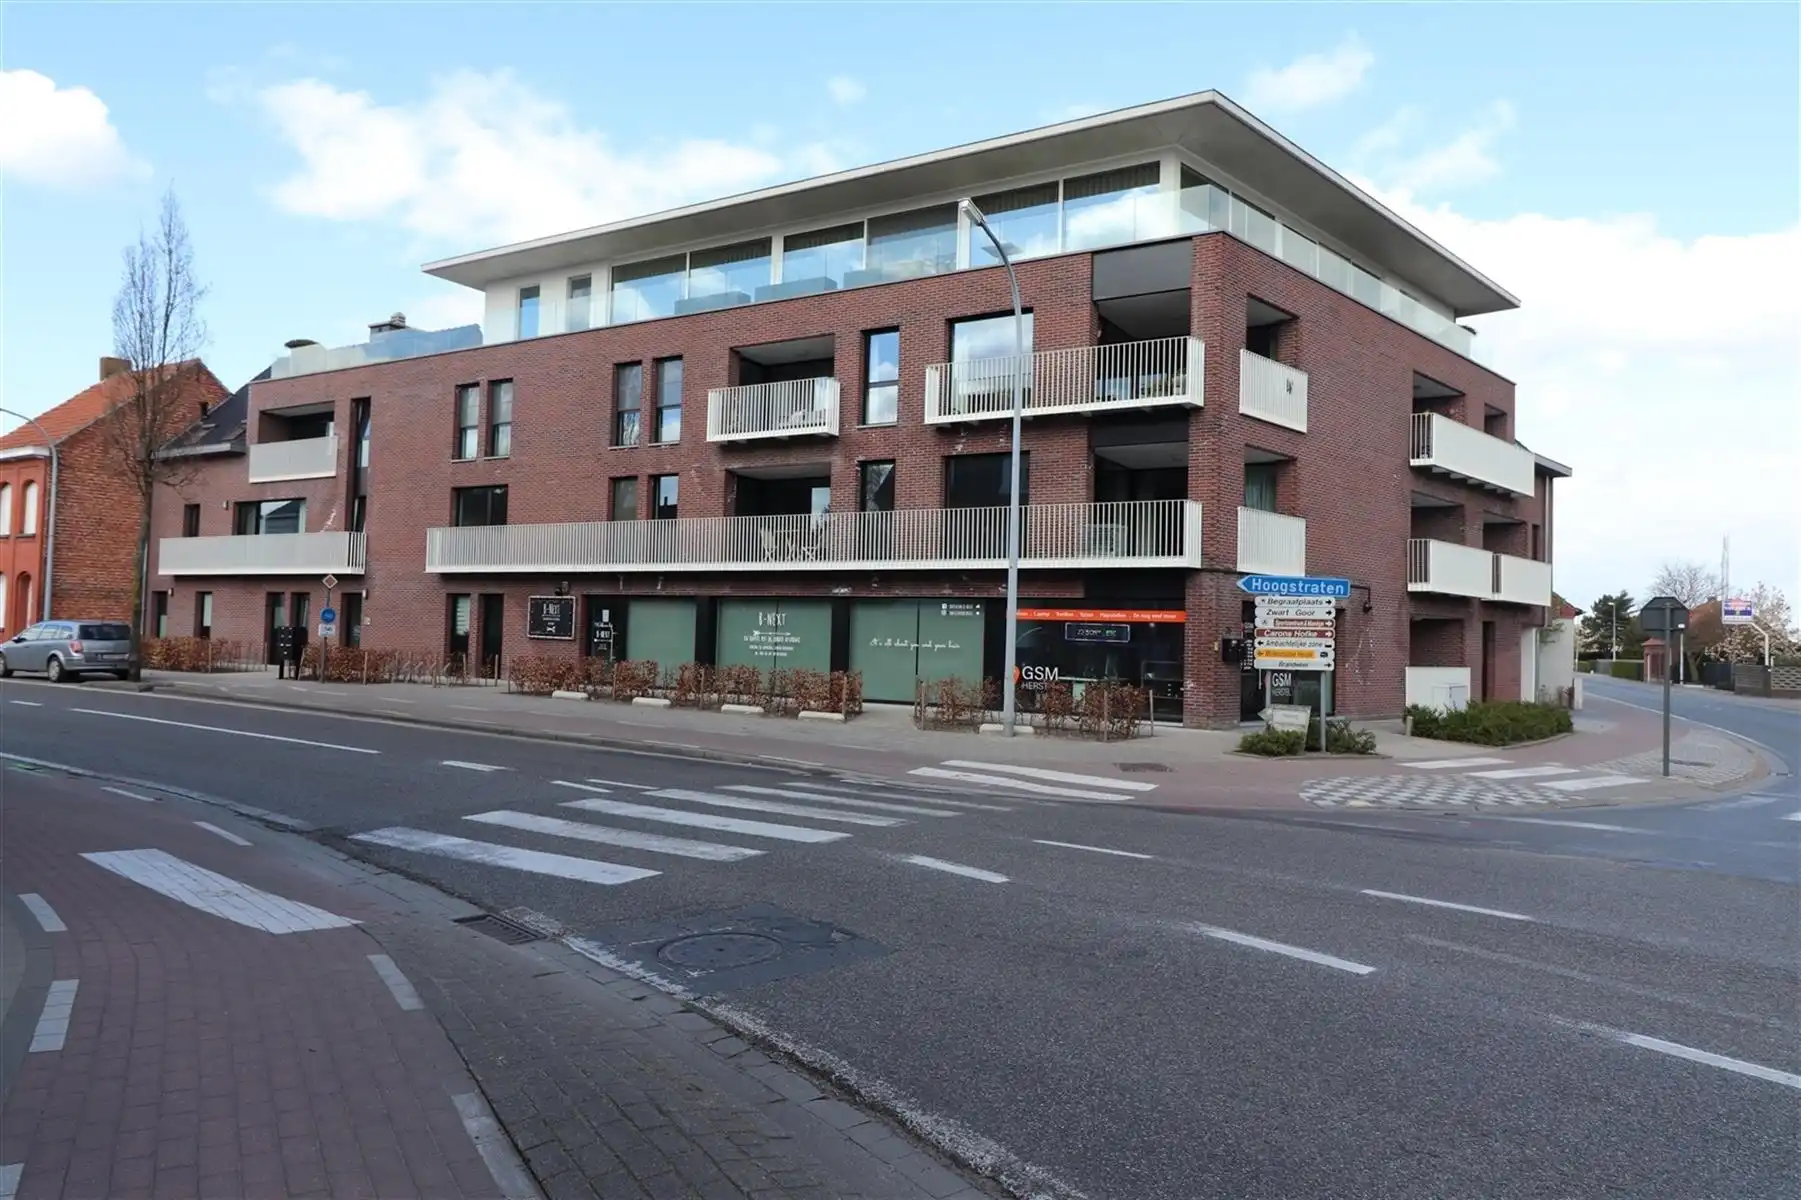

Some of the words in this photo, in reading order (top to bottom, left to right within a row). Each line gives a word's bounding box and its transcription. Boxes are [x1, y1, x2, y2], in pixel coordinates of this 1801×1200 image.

[1252, 578, 1344, 595] Hoogstraten
[1267, 598, 1323, 606] Begraafplaats
[758, 611, 787, 626] B-NEXT
[1266, 608, 1289, 616] Zwart
[1021, 666, 1059, 681] GSM
[1272, 673, 1292, 687] GSM
[1021, 681, 1048, 690] HERST
